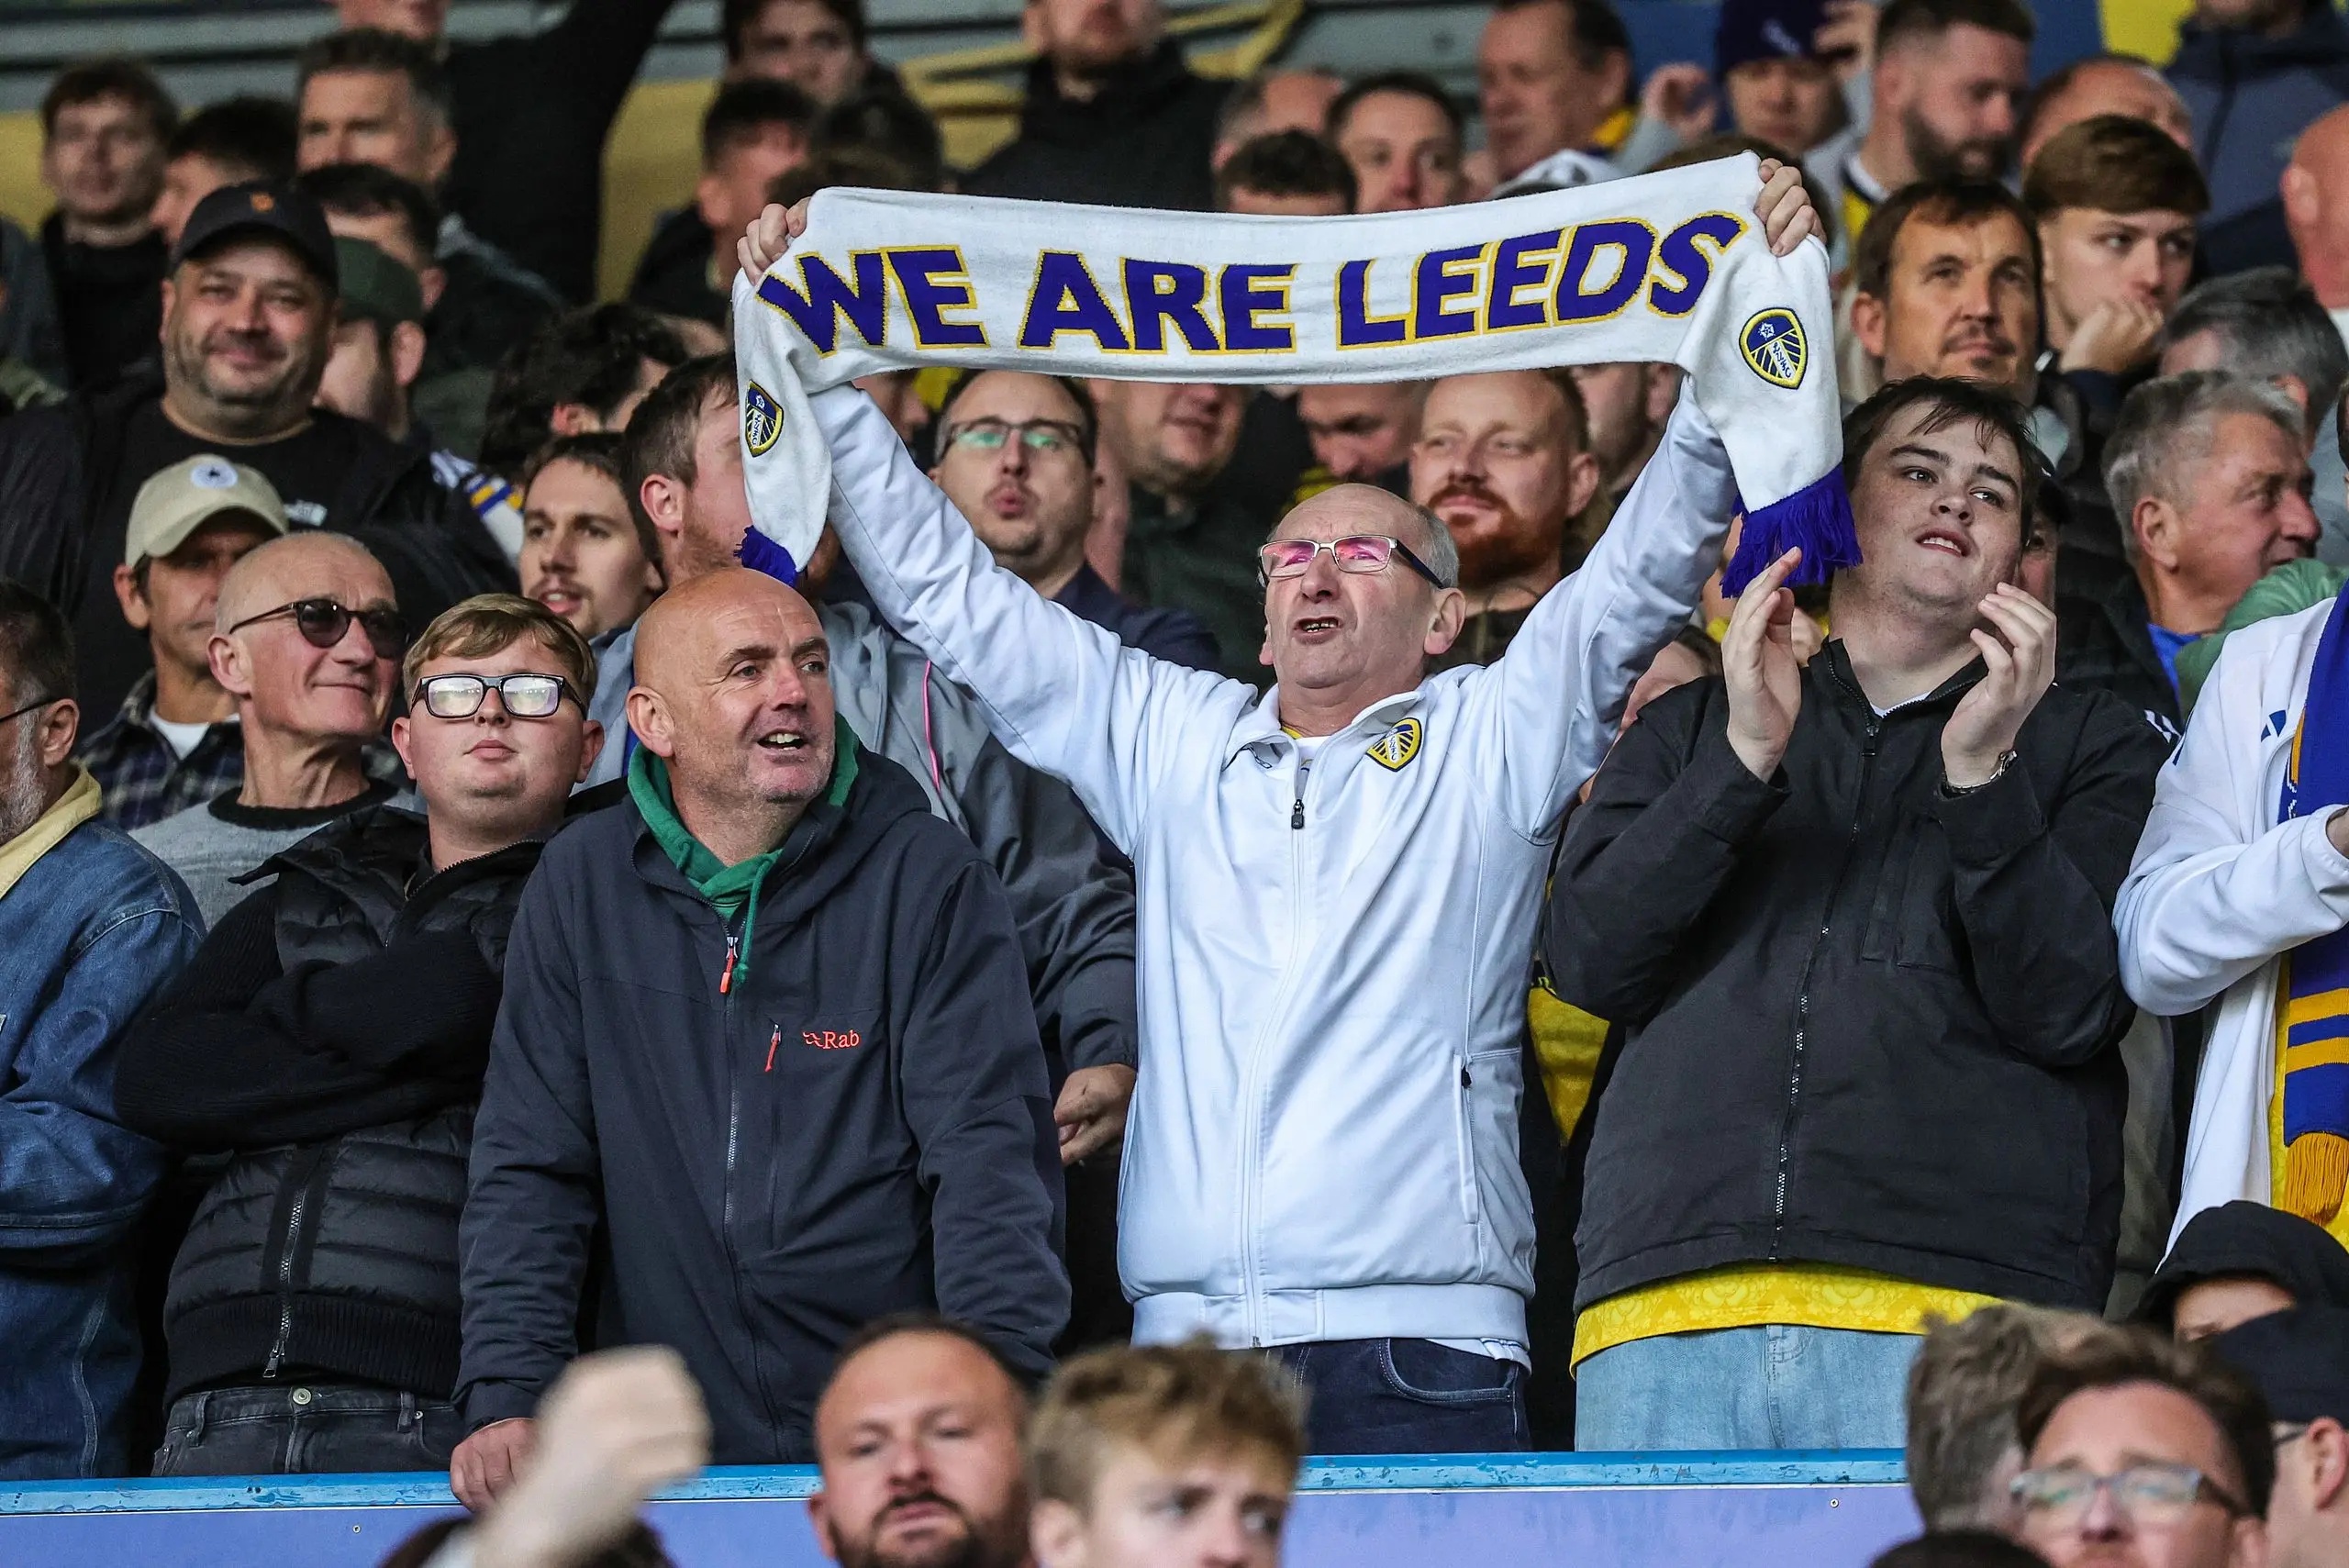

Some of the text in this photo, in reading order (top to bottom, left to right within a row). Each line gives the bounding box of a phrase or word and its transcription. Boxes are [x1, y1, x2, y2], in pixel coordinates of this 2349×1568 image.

[754, 209, 1749, 359] WE ARE LEEDS
[822, 1029, 860, 1050] Rab
